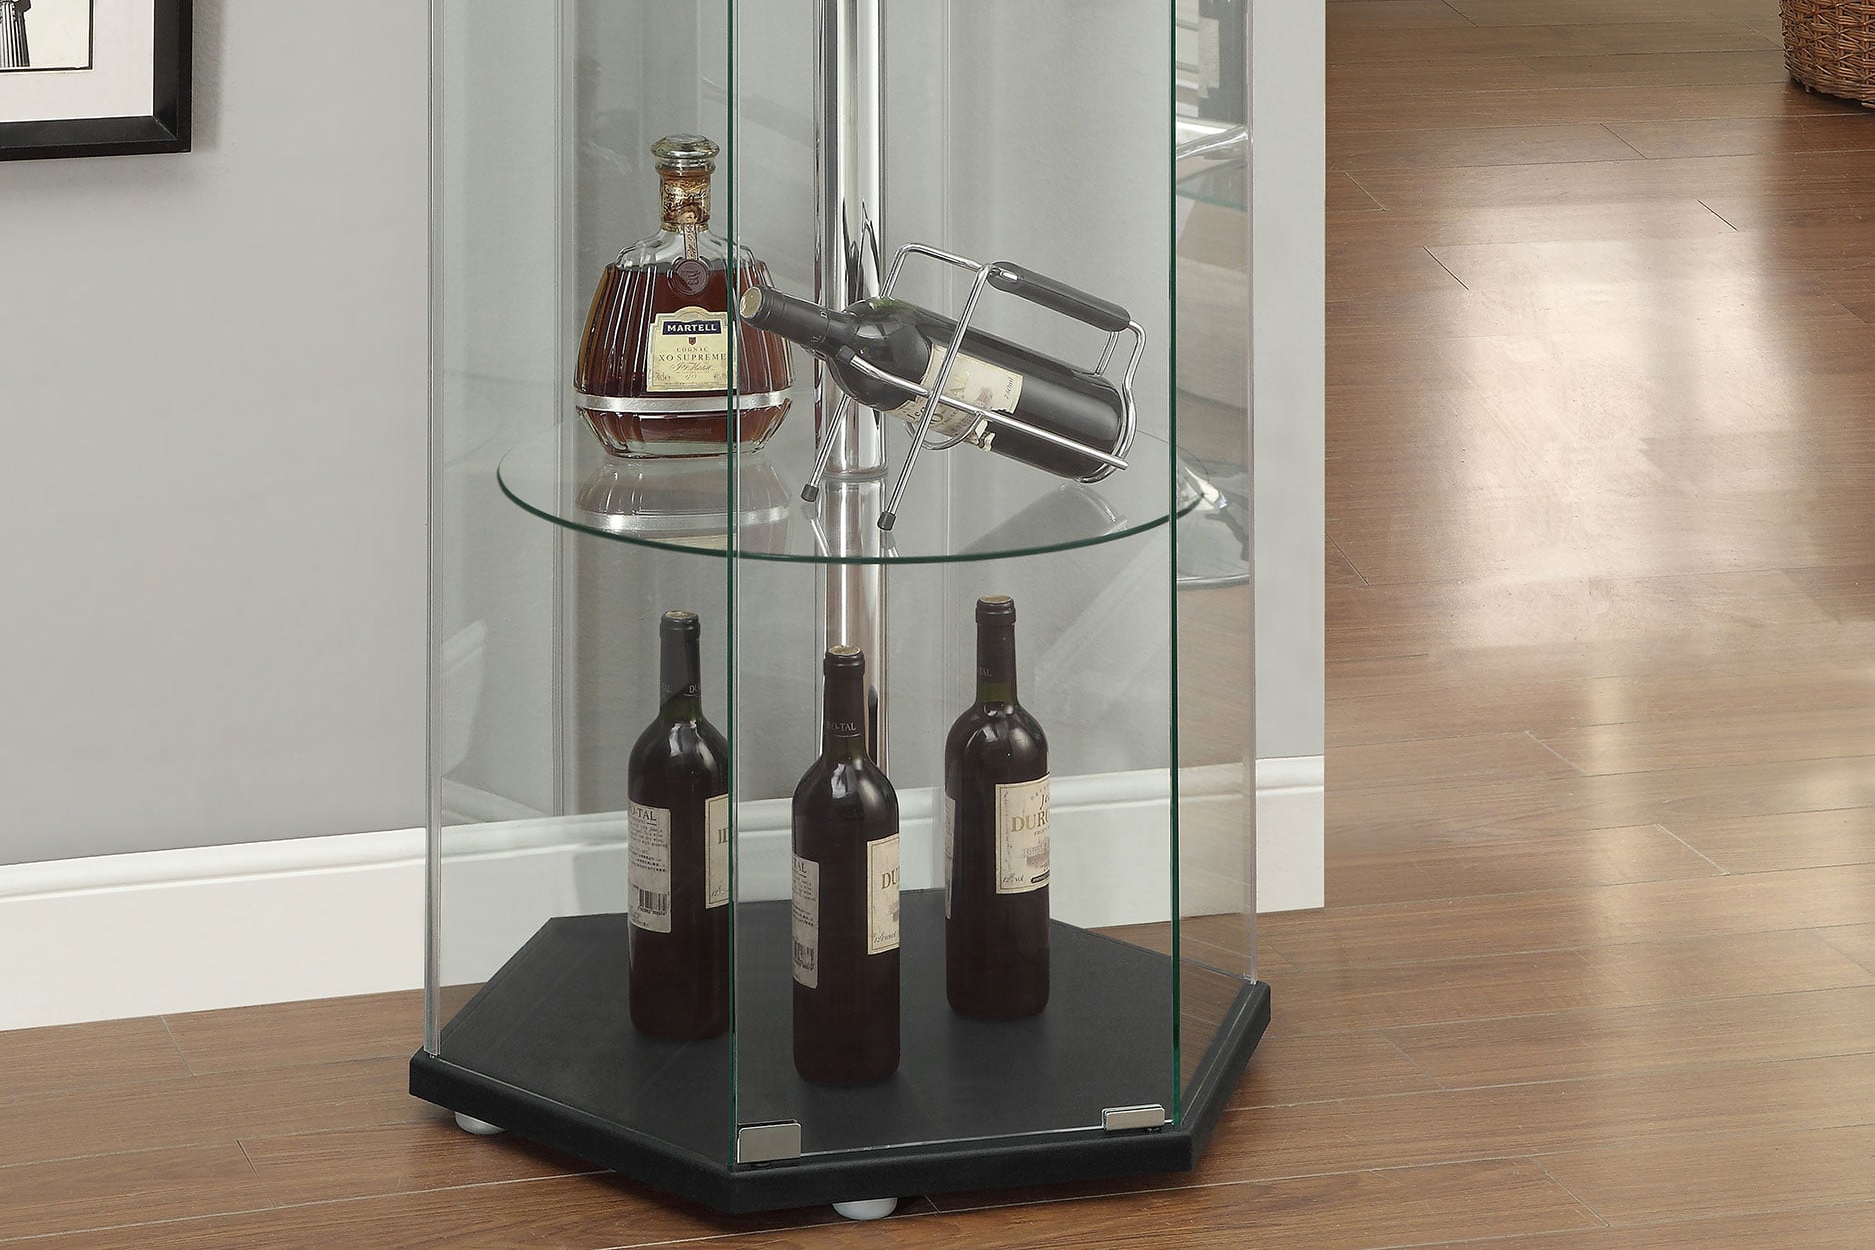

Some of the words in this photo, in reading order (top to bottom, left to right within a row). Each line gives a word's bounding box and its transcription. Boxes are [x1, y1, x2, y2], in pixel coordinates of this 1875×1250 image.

[667, 324, 717, 332] MARTELL
[659, 354, 674, 362] XO
[676, 353, 727, 361] SUPREME
[881, 865, 900, 890] DU
